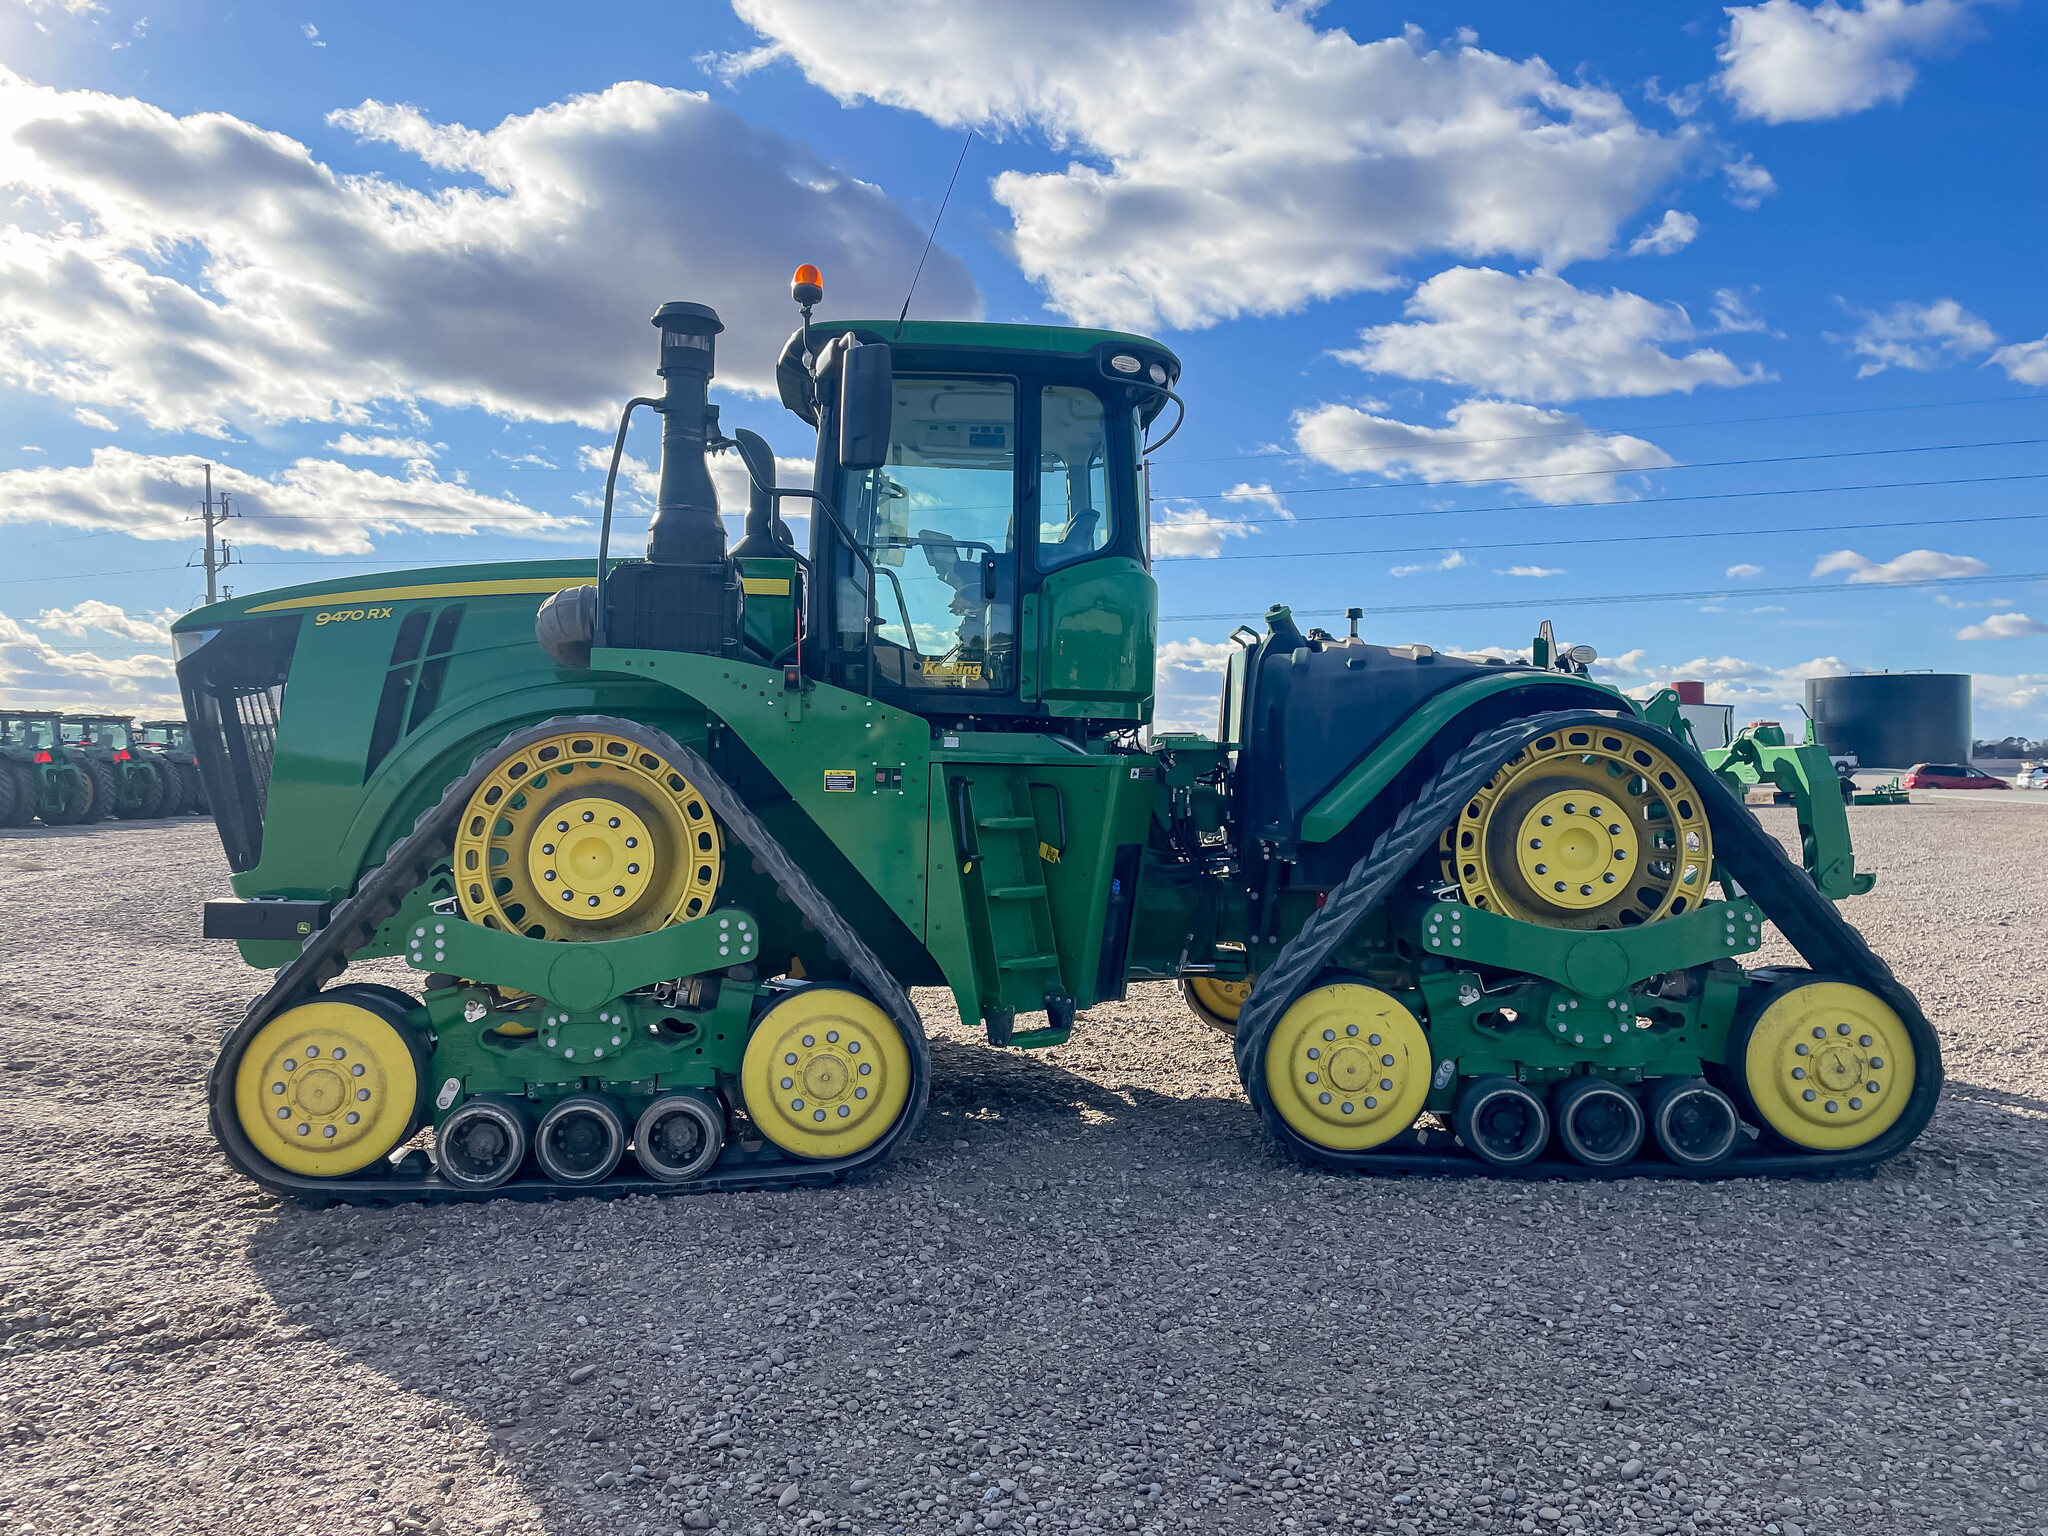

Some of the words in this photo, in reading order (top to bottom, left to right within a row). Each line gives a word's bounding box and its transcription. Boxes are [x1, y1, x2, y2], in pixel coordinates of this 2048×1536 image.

[315, 609, 365, 626] 9470
[367, 606, 394, 620] RX
[922, 661, 982, 681] Keating
